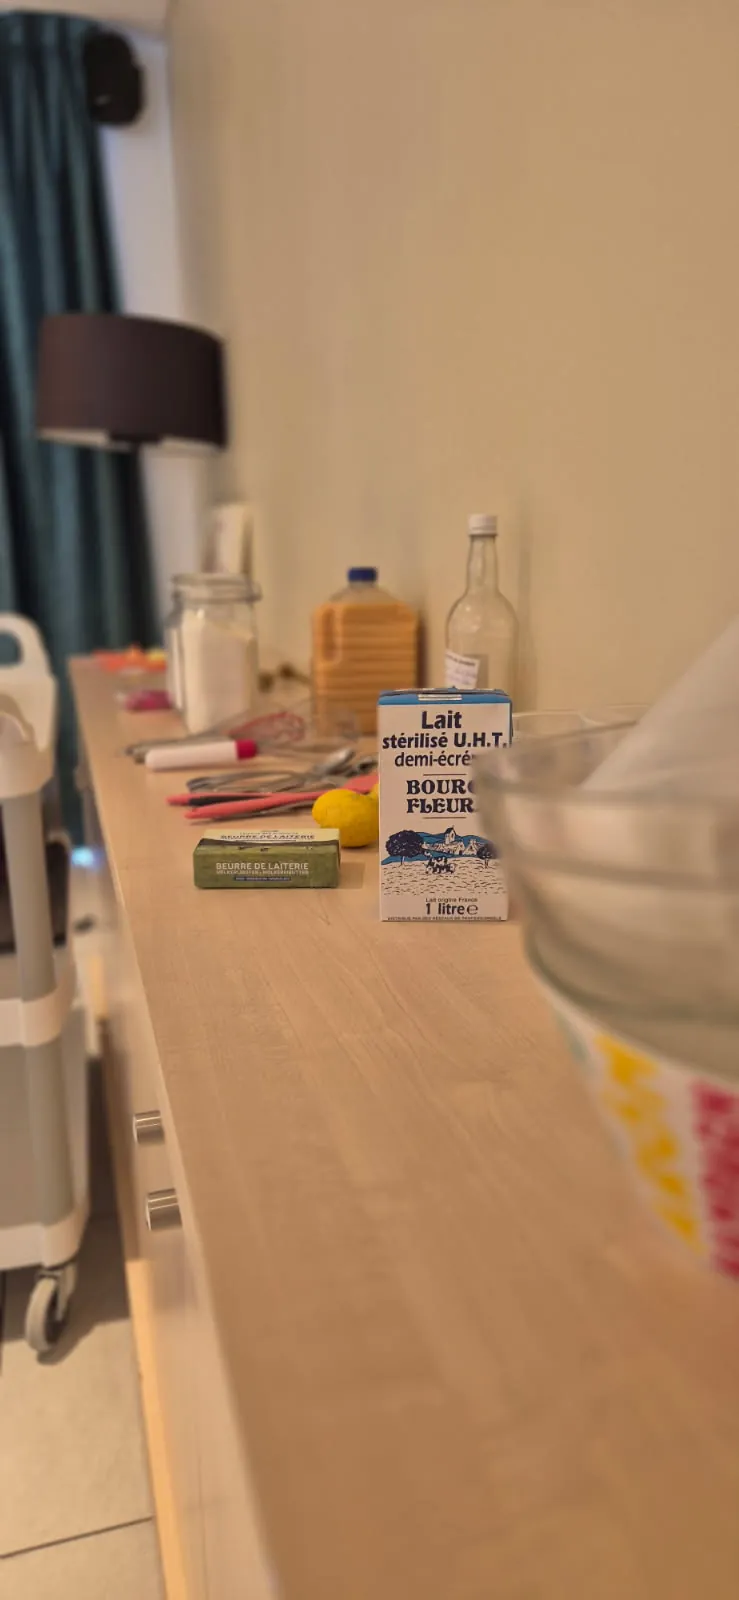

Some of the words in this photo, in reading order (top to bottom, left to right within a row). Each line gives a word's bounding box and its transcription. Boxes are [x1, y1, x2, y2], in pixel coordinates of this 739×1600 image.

[421, 710, 462, 729] Lait
[382, 732, 448, 749] stérilisé
[453, 732, 507, 748] U.H.T.
[394, 750, 477, 767] demi-écré
[406, 798, 478, 814] FLEUR
[215, 862, 252, 870] BEURRE
[254, 862, 266, 870] DE
[268, 862, 309, 870] LAITERIE
[425, 902, 431, 915] 1
[437, 902, 465, 915] litre
